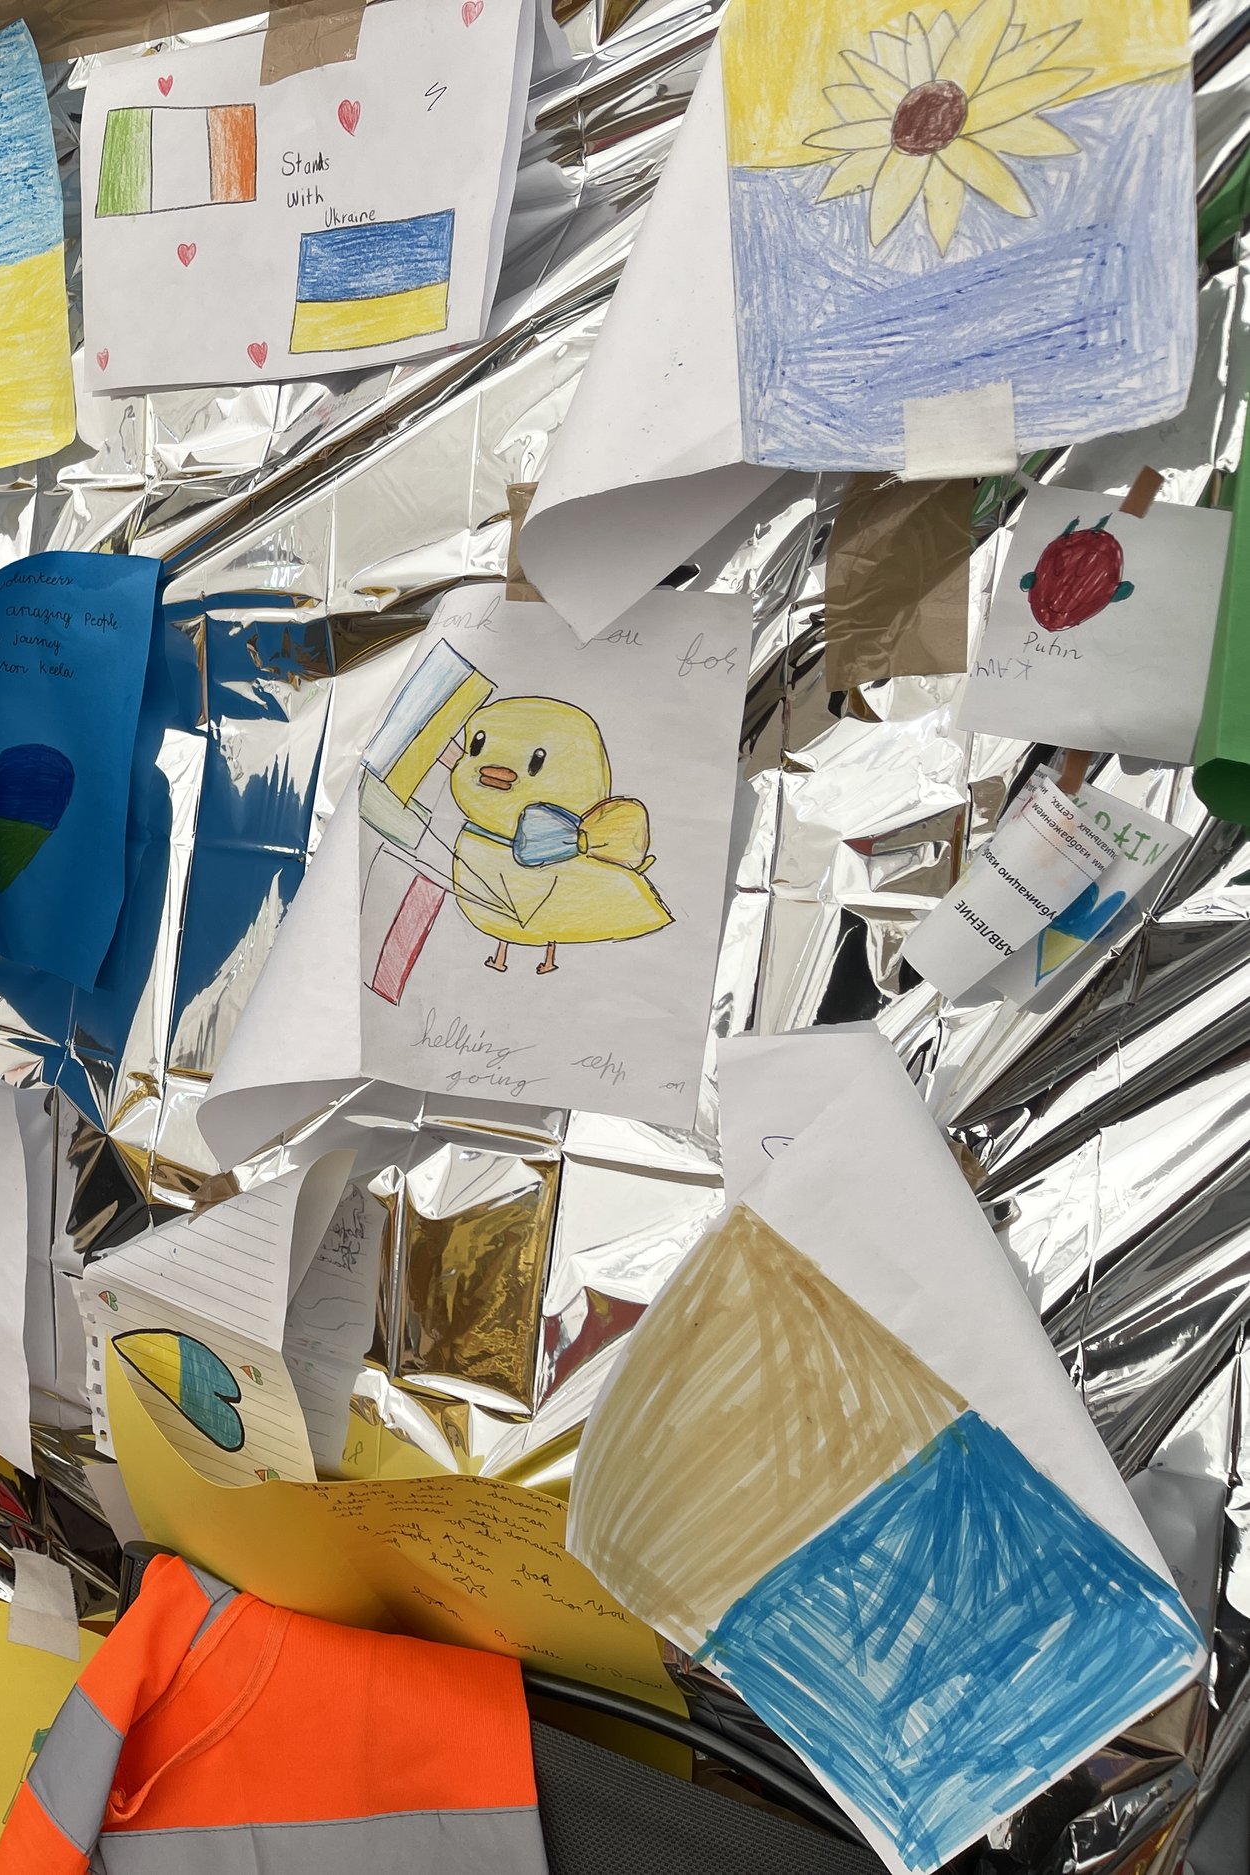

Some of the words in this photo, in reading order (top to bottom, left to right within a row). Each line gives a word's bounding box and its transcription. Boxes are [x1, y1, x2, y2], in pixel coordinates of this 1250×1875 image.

[324, 206, 376, 228] Ukraine
[6, 604, 74, 629] amazing
[1023, 631, 1084, 660] Putin
[998, 867, 1059, 920] убликацию
[954, 900, 1017, 957] АЯВЛЕНИЕ
